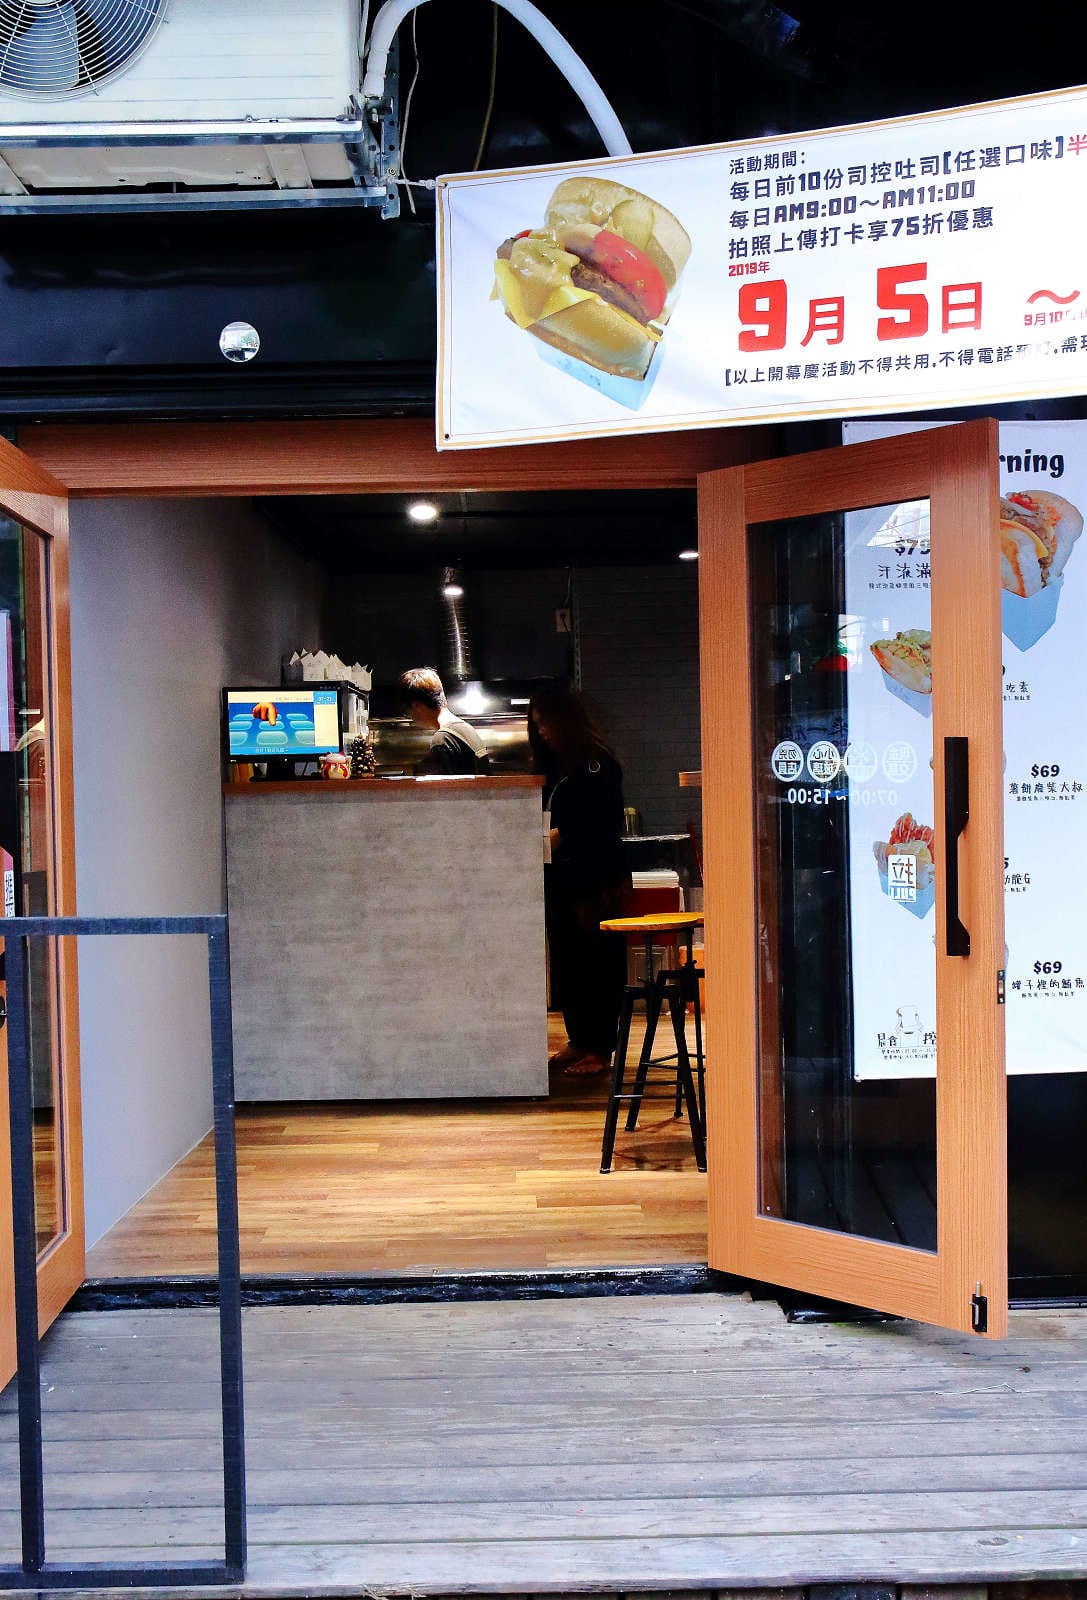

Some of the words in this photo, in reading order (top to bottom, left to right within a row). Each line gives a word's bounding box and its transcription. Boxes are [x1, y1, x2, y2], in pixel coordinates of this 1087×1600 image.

[728, 206, 994, 260] 拍照上傳打卡享75折優惠
[728, 261, 770, 277] 2019年
[1031, 763, 1060, 778] $69
[1033, 960, 1062, 975] $69
